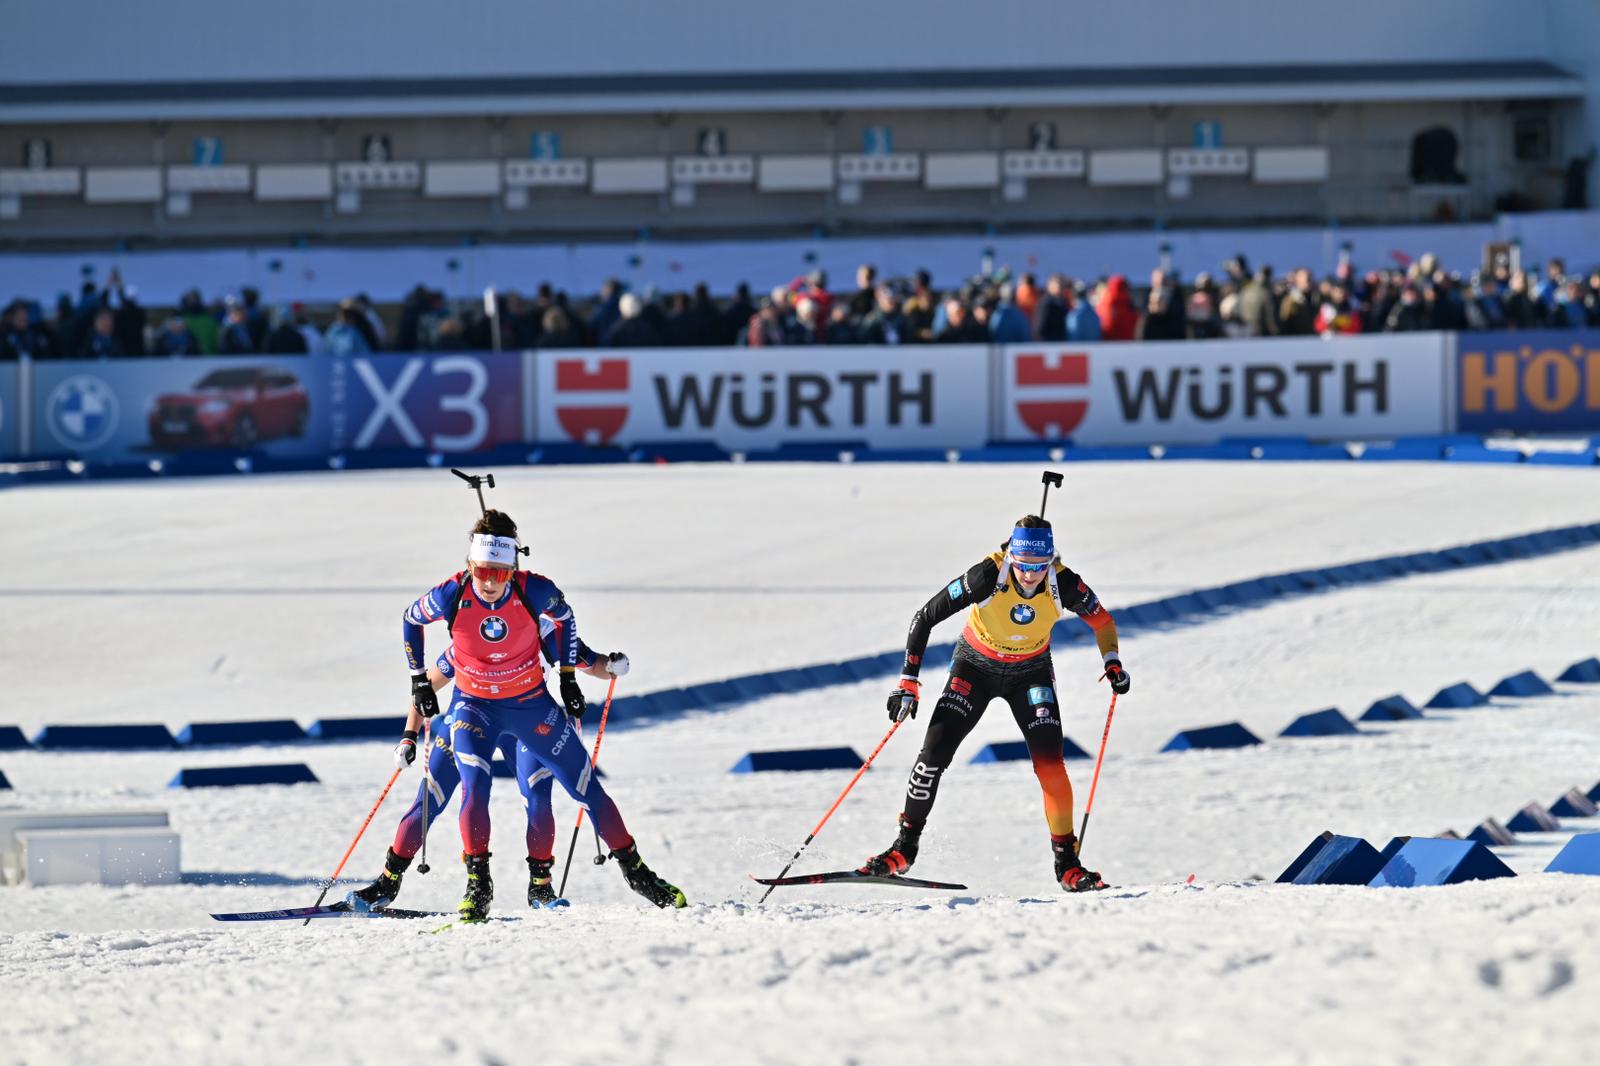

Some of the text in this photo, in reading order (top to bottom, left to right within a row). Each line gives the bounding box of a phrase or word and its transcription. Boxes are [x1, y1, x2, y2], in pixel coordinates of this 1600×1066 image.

[352, 357, 490, 451] X3
[653, 370, 934, 430] WÜRTH
[1113, 360, 1390, 422] WÜRTH
[551, 721, 573, 756] CRAFT
[907, 761, 938, 800] GER
